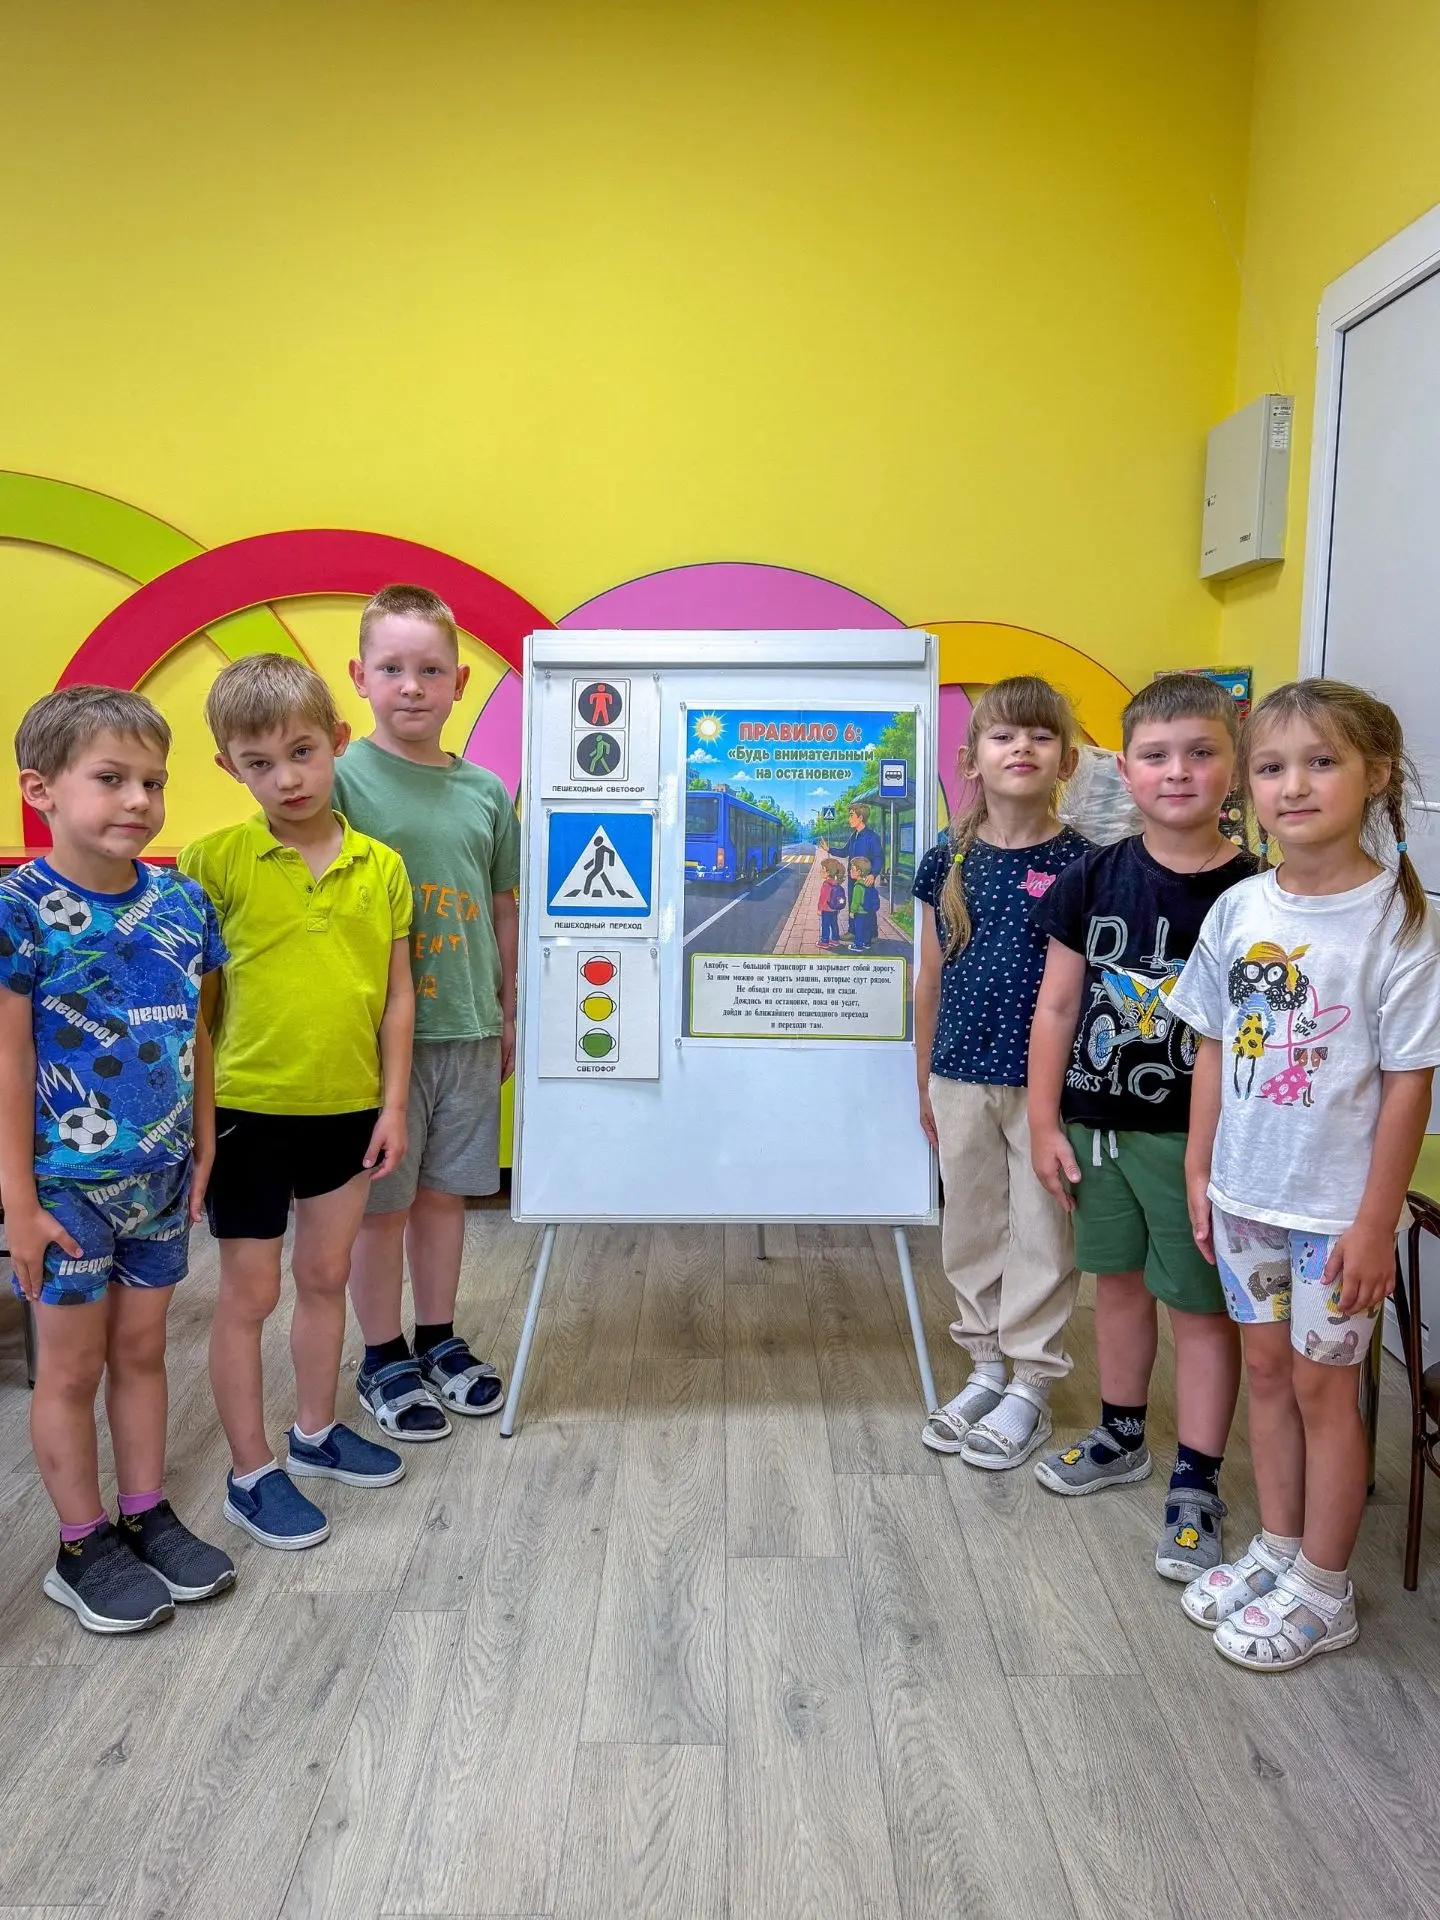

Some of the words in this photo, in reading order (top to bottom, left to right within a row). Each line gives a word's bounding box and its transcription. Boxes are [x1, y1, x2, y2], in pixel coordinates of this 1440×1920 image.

[739, 722, 838, 742] ПРАВИЛО
[843, 722, 862, 742] 6:
[728, 746, 770, 763] «Будь
[774, 749, 874, 761] внимательным
[756, 769, 771, 779] на
[775, 769, 852, 780] остановке»
[552, 785, 603, 793] ПЕШЕХОДНЫЙ
[554, 922, 605, 930] ПЕШЕХОДНЫЙ
[609, 922, 642, 930] ПЕРЕХОД
[703, 961, 729, 971] Автобус
[743, 962, 771, 970] большой
[774, 964, 806, 972] транспорт
[816, 964, 850, 973] закрывает
[853, 963, 870, 971] собой
[707, 973, 714, 981] За
[767, 975, 793, 983] увидеть
[853, 977, 867, 985] едут
[748, 985, 770, 993] обходи
[796, 987, 824, 995] спереди,
[733, 997, 761, 1005] Дождись
[127, 1003, 188, 1026] Football
[722, 1008, 742, 1016] дойди
[754, 1008, 795, 1017] ближайшего
[841, 1011, 869, 1019] перехода
[41, 995, 120, 1048] Football
[778, 1022, 806, 1030] переходи
[576, 1065, 616, 1073] СВЕТОФОР
[138, 1094, 188, 1154] Football
[59, 1254, 113, 1276] ootball
